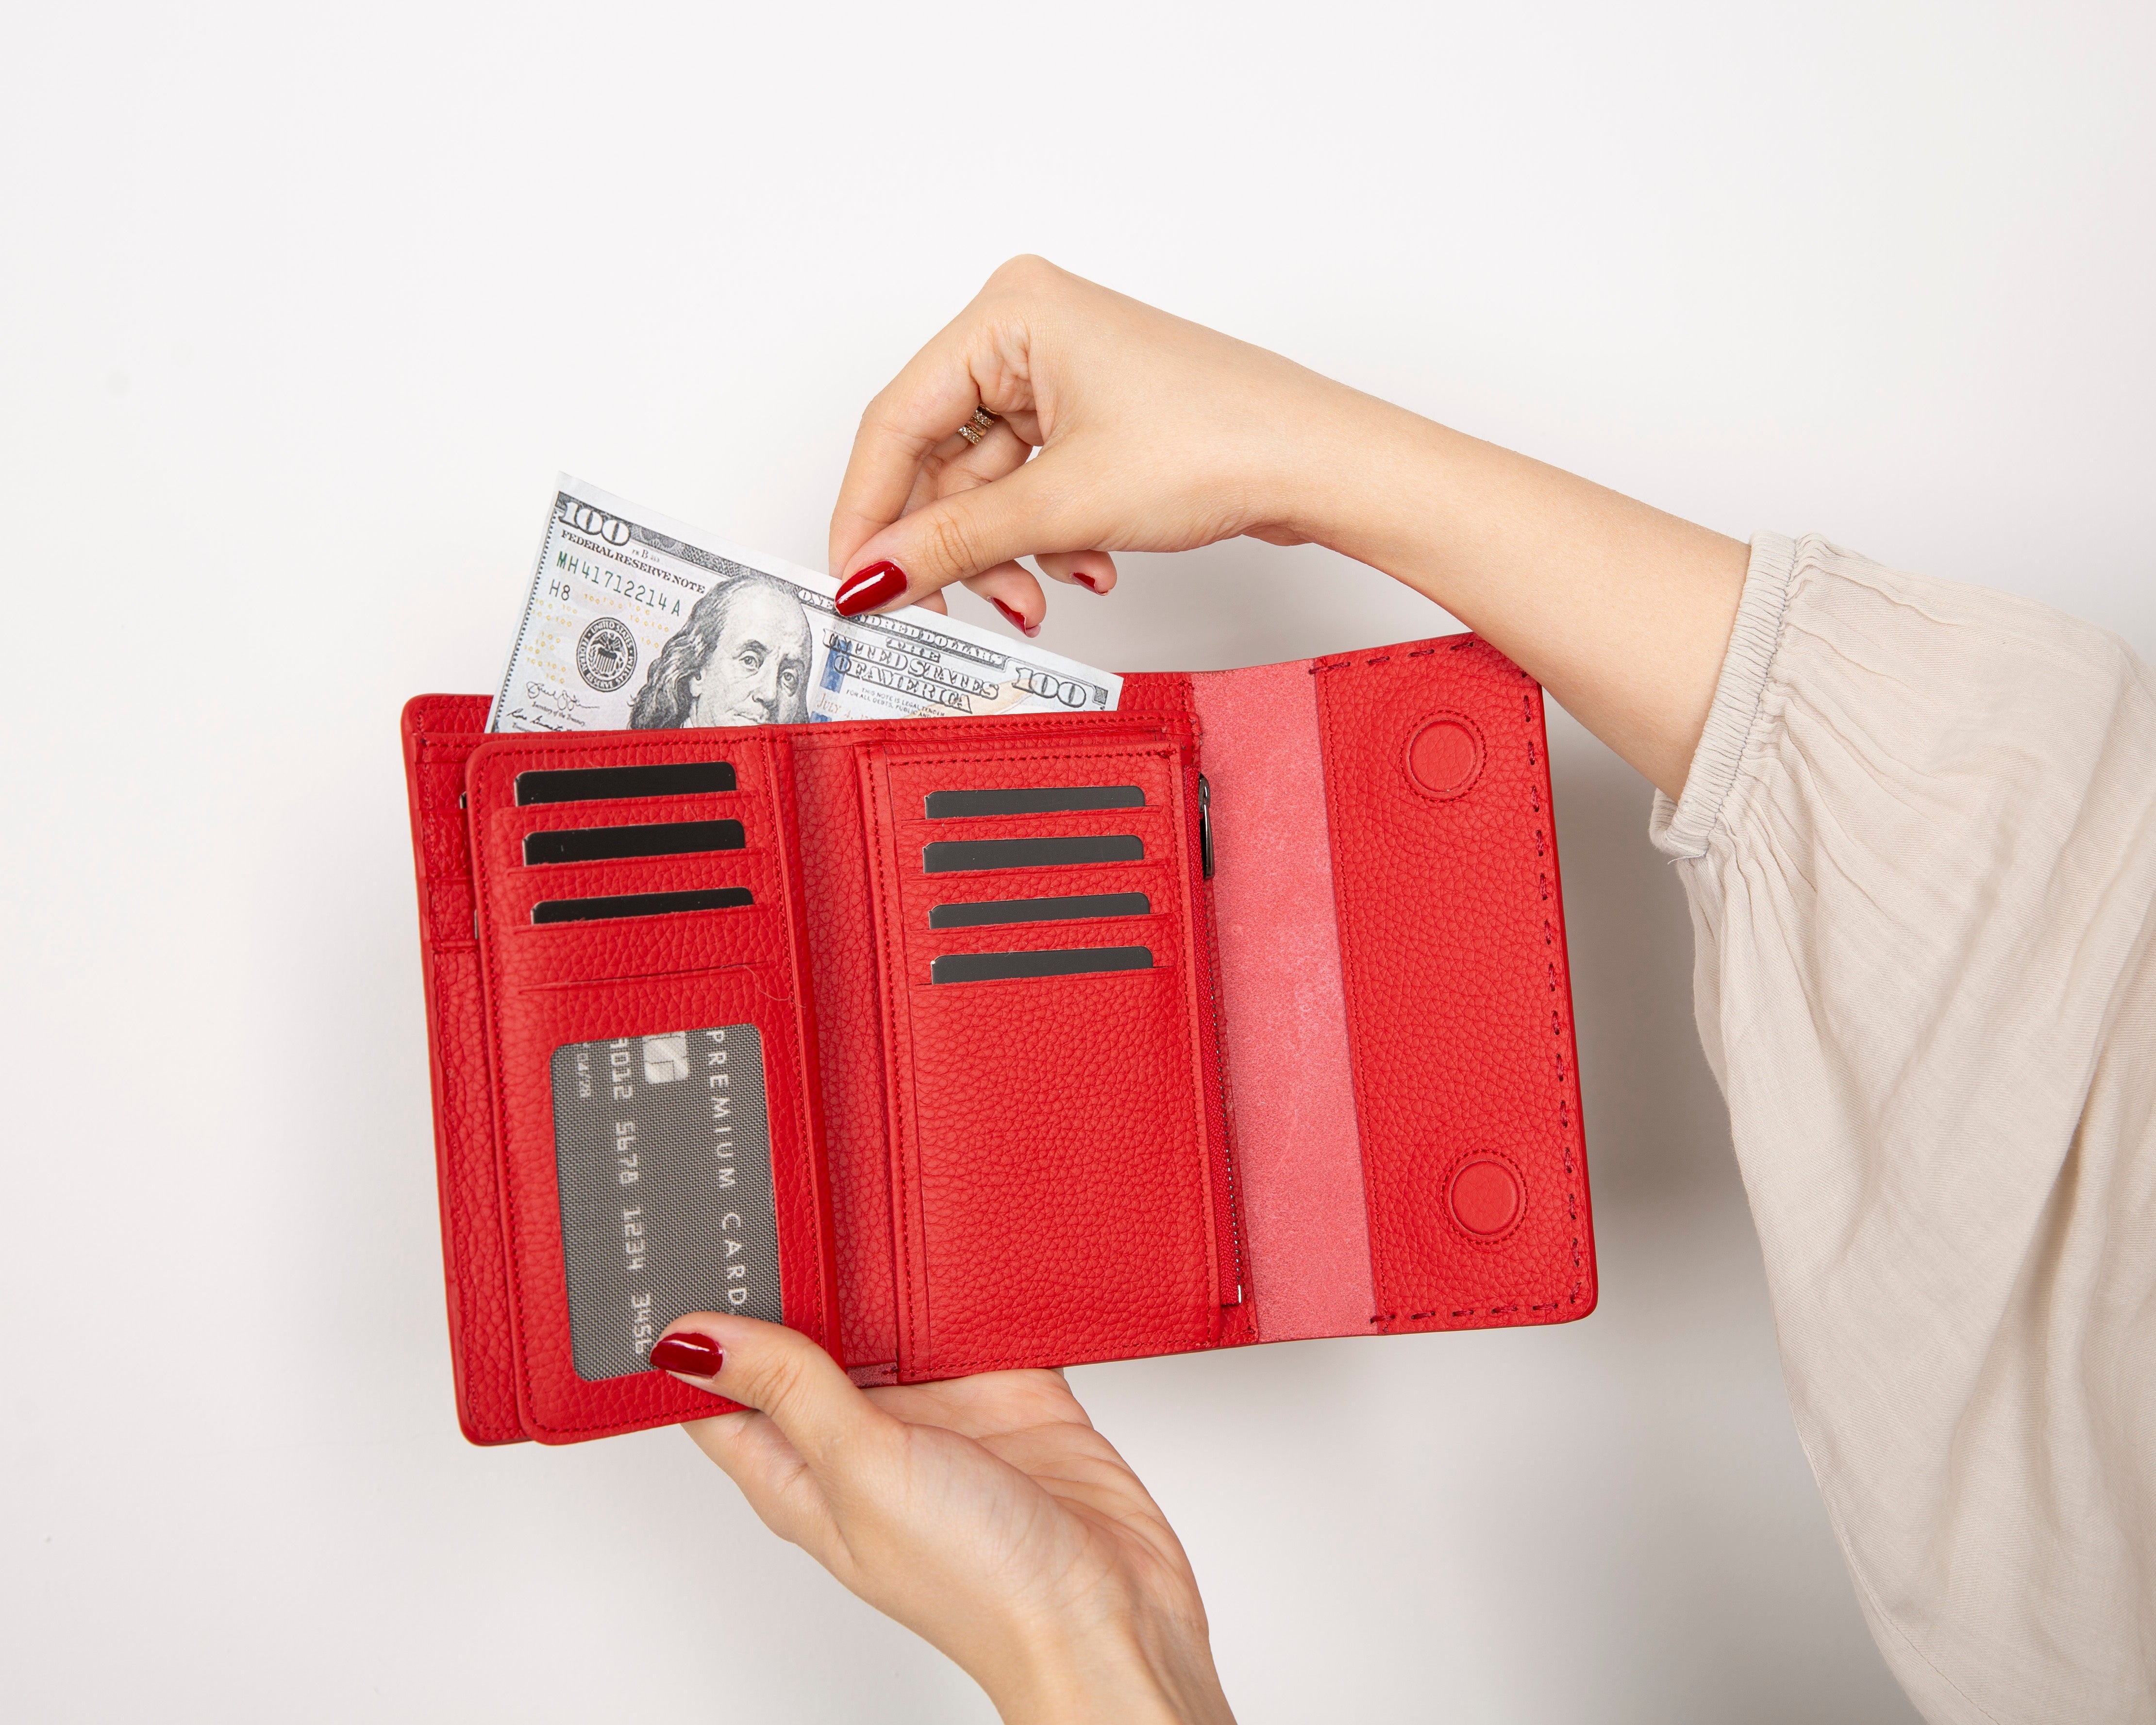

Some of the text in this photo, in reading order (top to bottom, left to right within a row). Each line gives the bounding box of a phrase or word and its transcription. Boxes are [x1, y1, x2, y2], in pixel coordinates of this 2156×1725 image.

[558, 501, 631, 546] 100
[549, 579, 571, 601] H8
[561, 529, 705, 594] FEDERAL RESERVE NOTE
[798, 589, 834, 609] ONE
[922, 631, 1003, 666] DOLLARS
[886, 636, 941, 663] THE
[822, 628, 999, 700] UNITED STATES
[834, 655, 973, 714] OF AMERICA
[1012, 666, 1086, 708] 100
[817, 693, 842, 714] JULY
[616, 1122, 639, 1186] 5678
[706, 1030, 747, 1306] PREMIUM CARD
[623, 1207, 647, 1271] 1234
[631, 1293, 652, 1355] 3456
